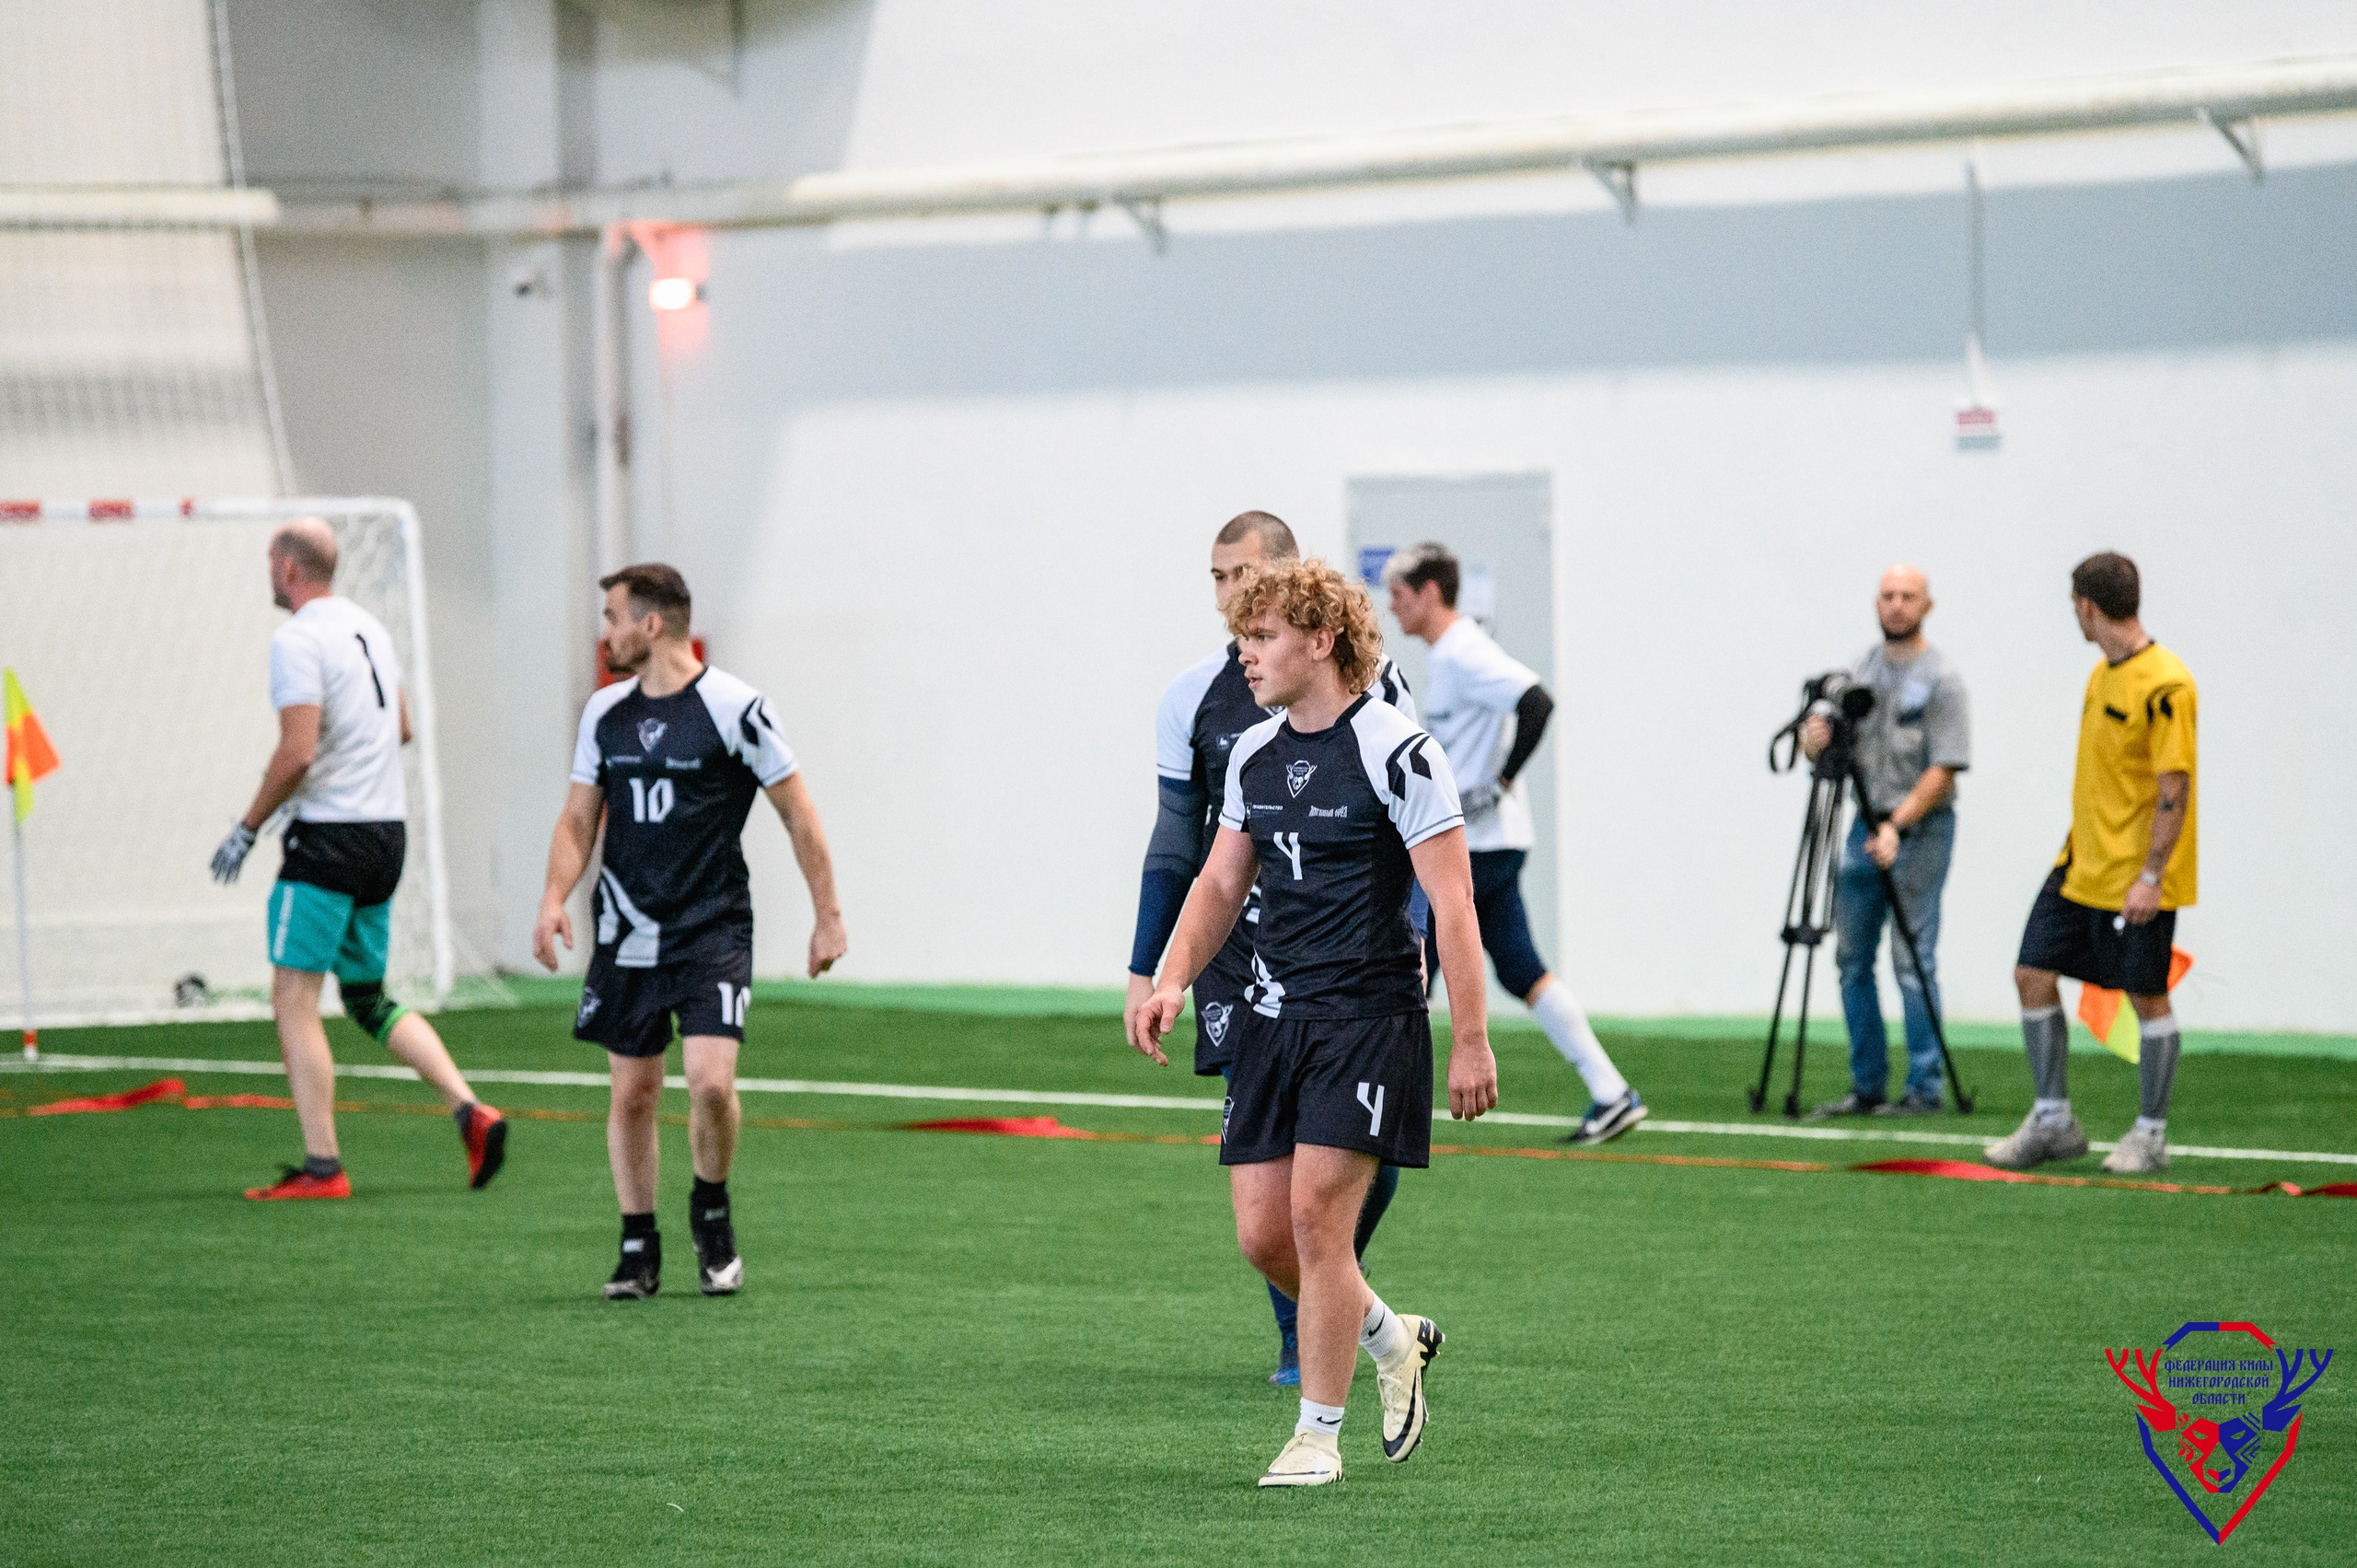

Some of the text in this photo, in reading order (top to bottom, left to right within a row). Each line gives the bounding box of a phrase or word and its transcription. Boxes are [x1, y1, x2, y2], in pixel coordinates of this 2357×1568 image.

[629, 777, 675, 823] 10
[1273, 831, 1303, 880] 4
[1356, 1081, 1385, 1137] 4
